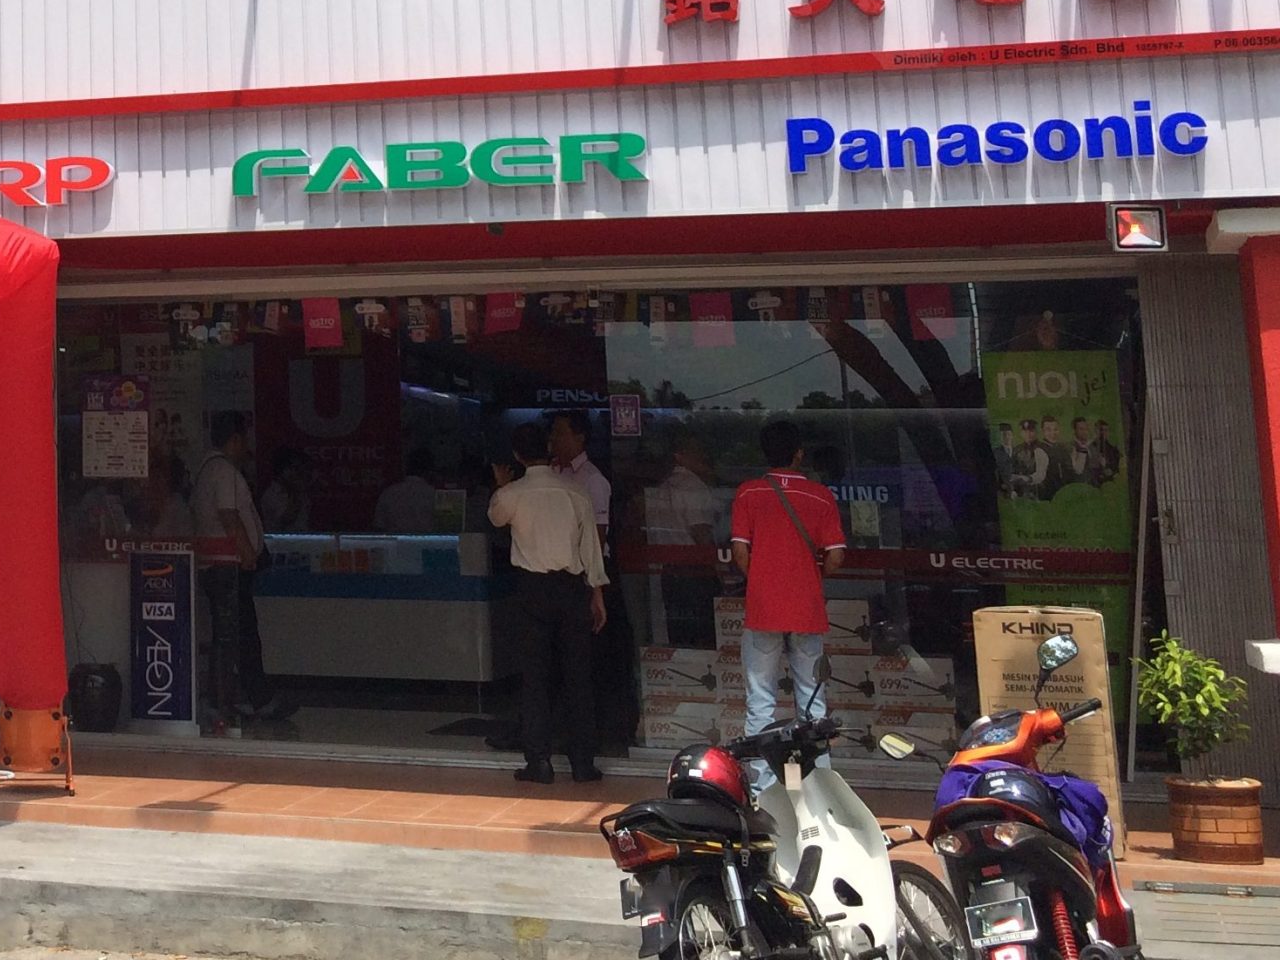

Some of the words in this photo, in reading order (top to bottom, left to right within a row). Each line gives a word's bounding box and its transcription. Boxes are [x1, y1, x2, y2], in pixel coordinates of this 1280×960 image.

[893, 51, 944, 66] Dimiliki
[948, 50, 977, 63] oleh
[989, 48, 1001, 60] U
[1004, 45, 1056, 60] Electric
[1096, 41, 1125, 54] Bhd
[785, 100, 1208, 174] Panasonic
[232, 132, 648, 196] FABER
[929, 552, 946, 568] U
[951, 557, 1045, 571] ELECTRIC
[145, 605, 174, 617] VISA
[1002, 621, 1074, 635] KHIND
[1003, 673, 1031, 683] MESIN
[1032, 673, 1085, 683] PBASUH
[1005, 684, 1084, 694] SEMI-ATOMATIK
